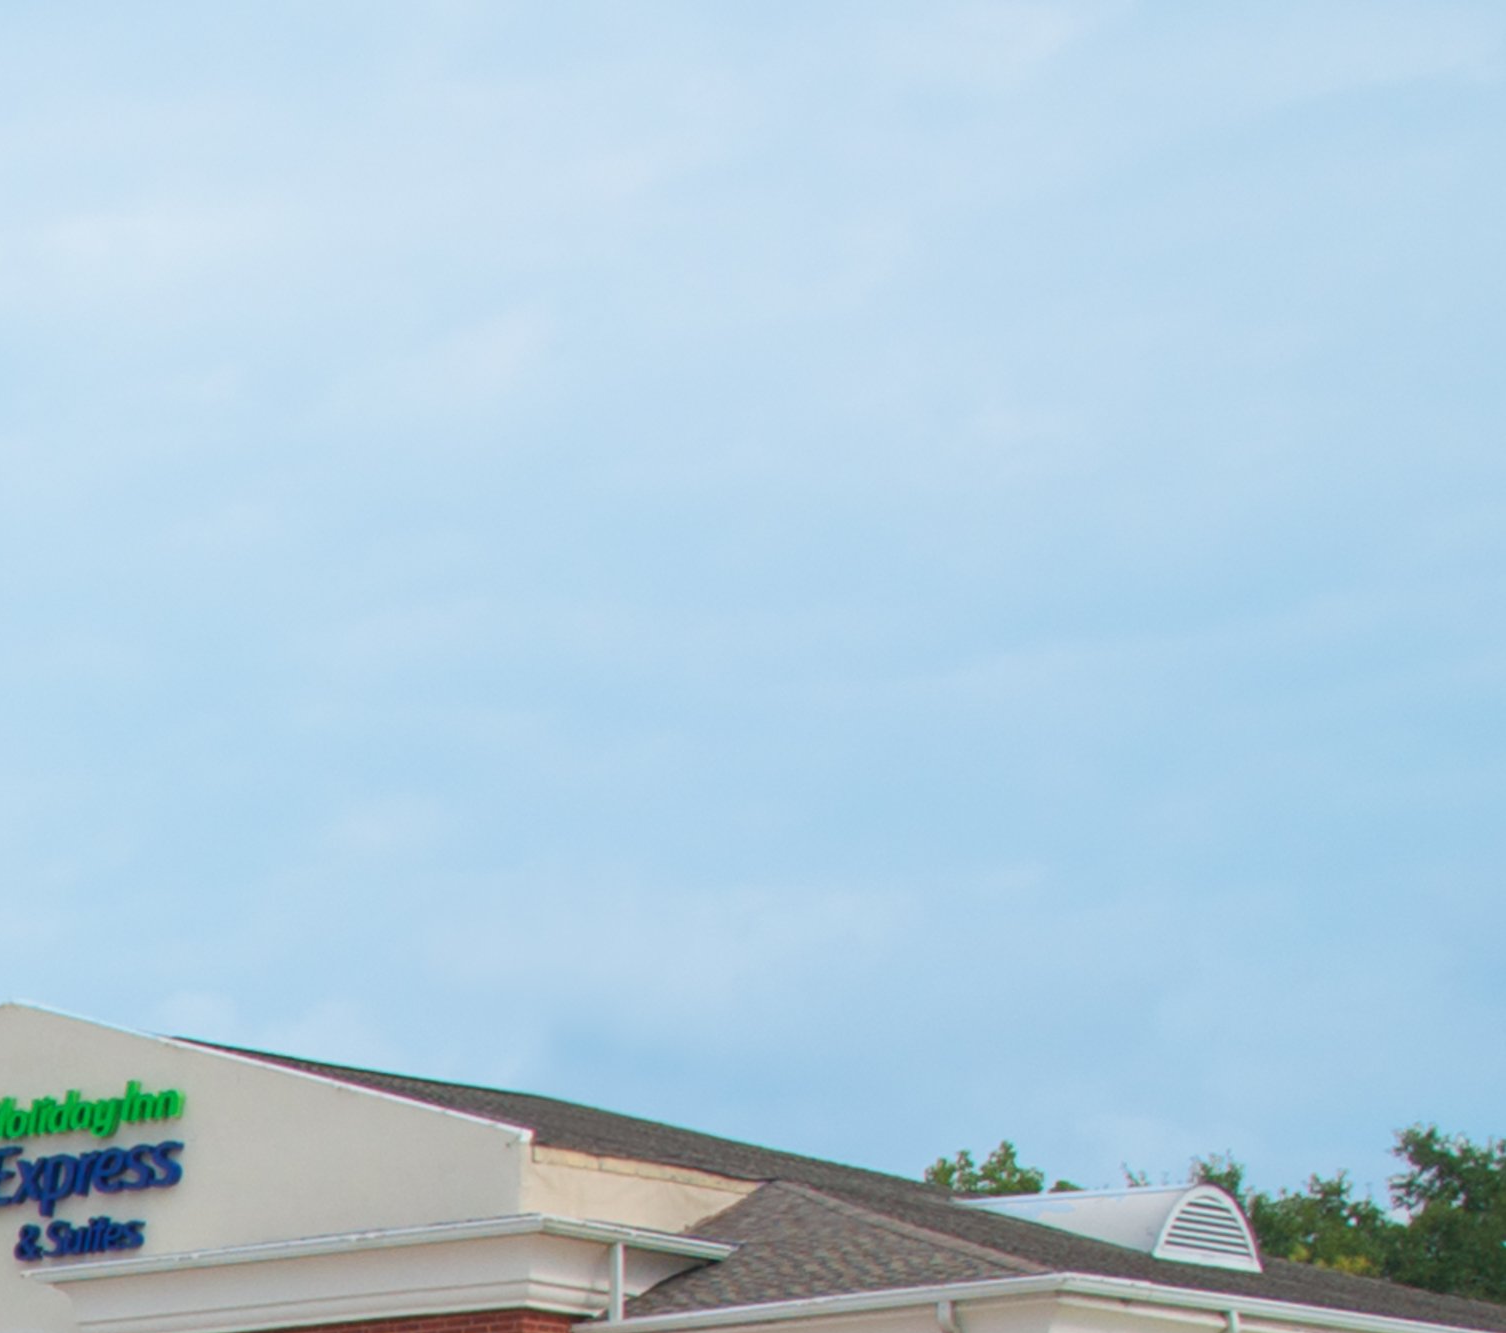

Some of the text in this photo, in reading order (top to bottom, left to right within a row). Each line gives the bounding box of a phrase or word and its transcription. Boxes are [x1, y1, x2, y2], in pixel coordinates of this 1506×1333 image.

[119, 1080, 186, 1123] Inn
[13, 1215, 147, 1262] & Suites
